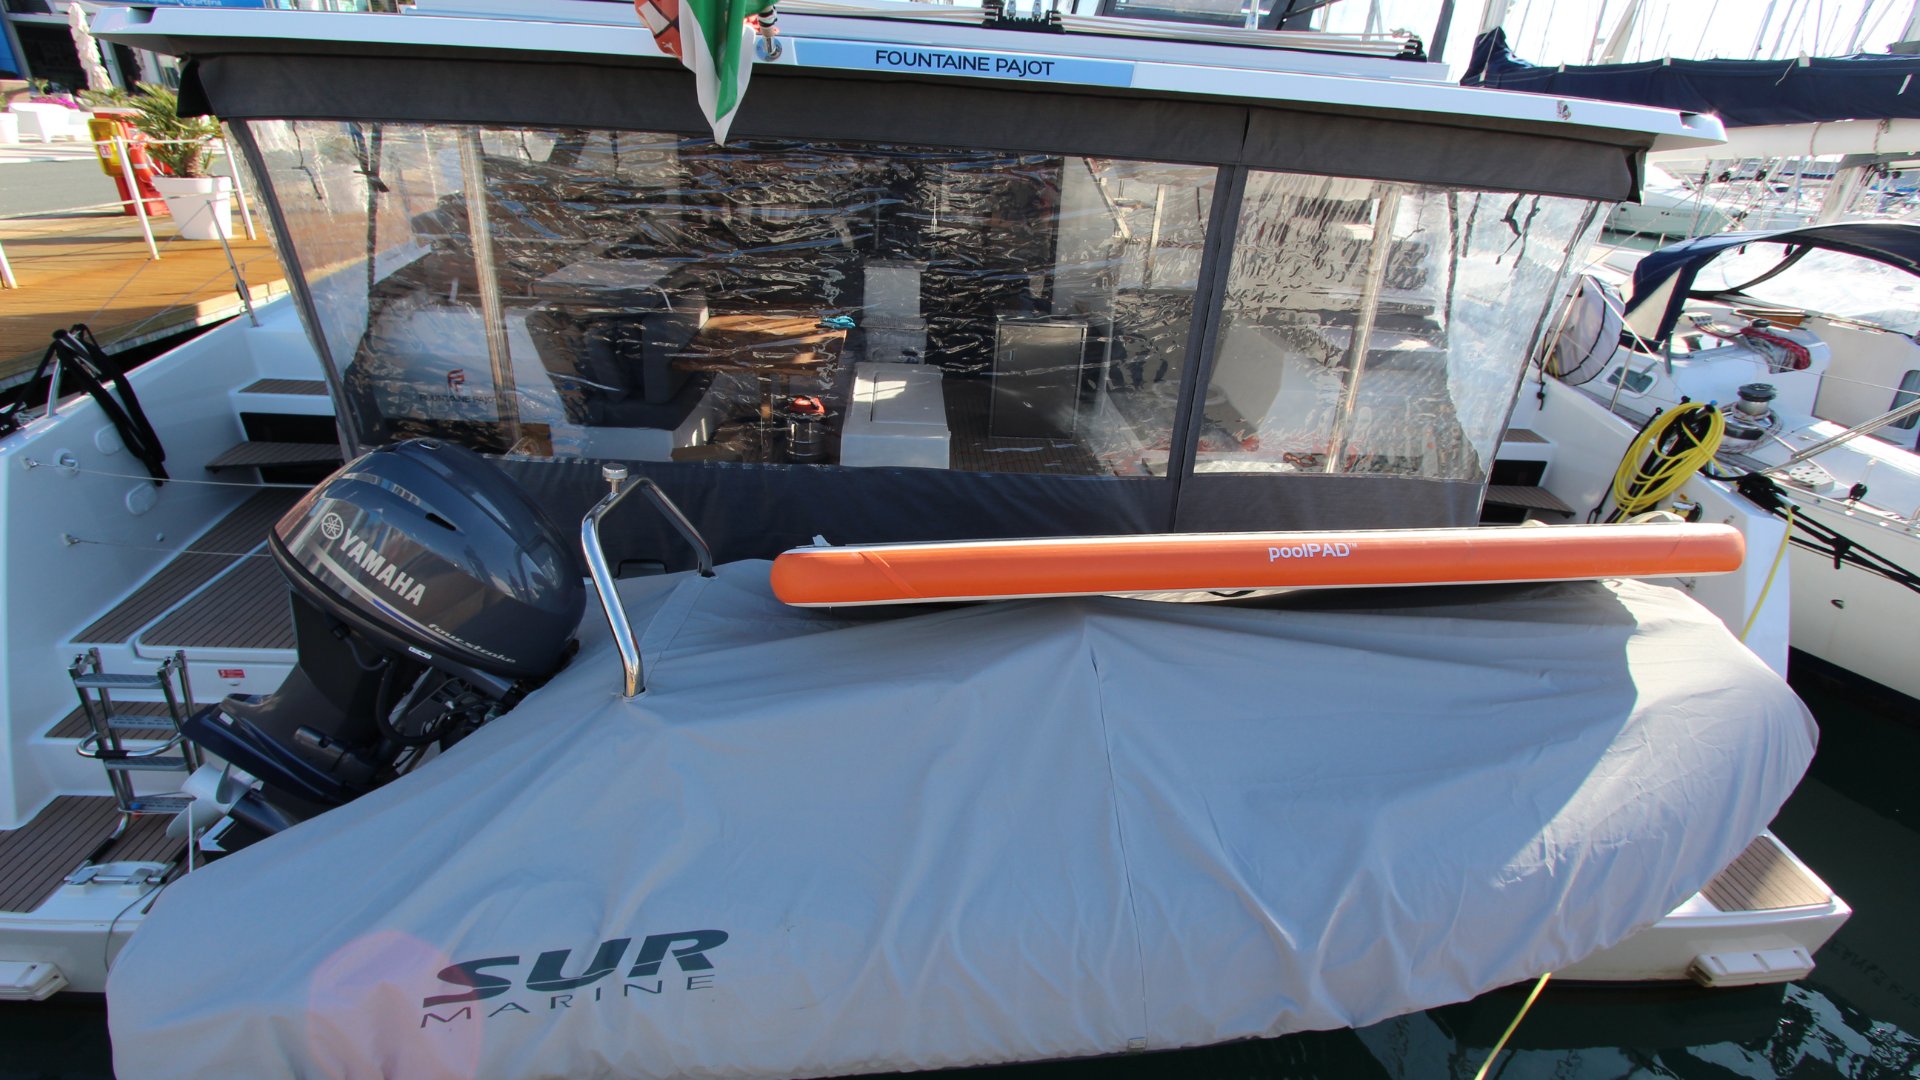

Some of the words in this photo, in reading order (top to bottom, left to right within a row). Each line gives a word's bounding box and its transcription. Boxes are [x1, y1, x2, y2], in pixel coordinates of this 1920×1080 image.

[875, 49, 990, 72] FOUNTAINE
[995, 57, 1055, 77] PAJOT
[340, 528, 426, 606] YAMAHA
[420, 974, 715, 1028] MARINE
[422, 929, 729, 1008] SUR
